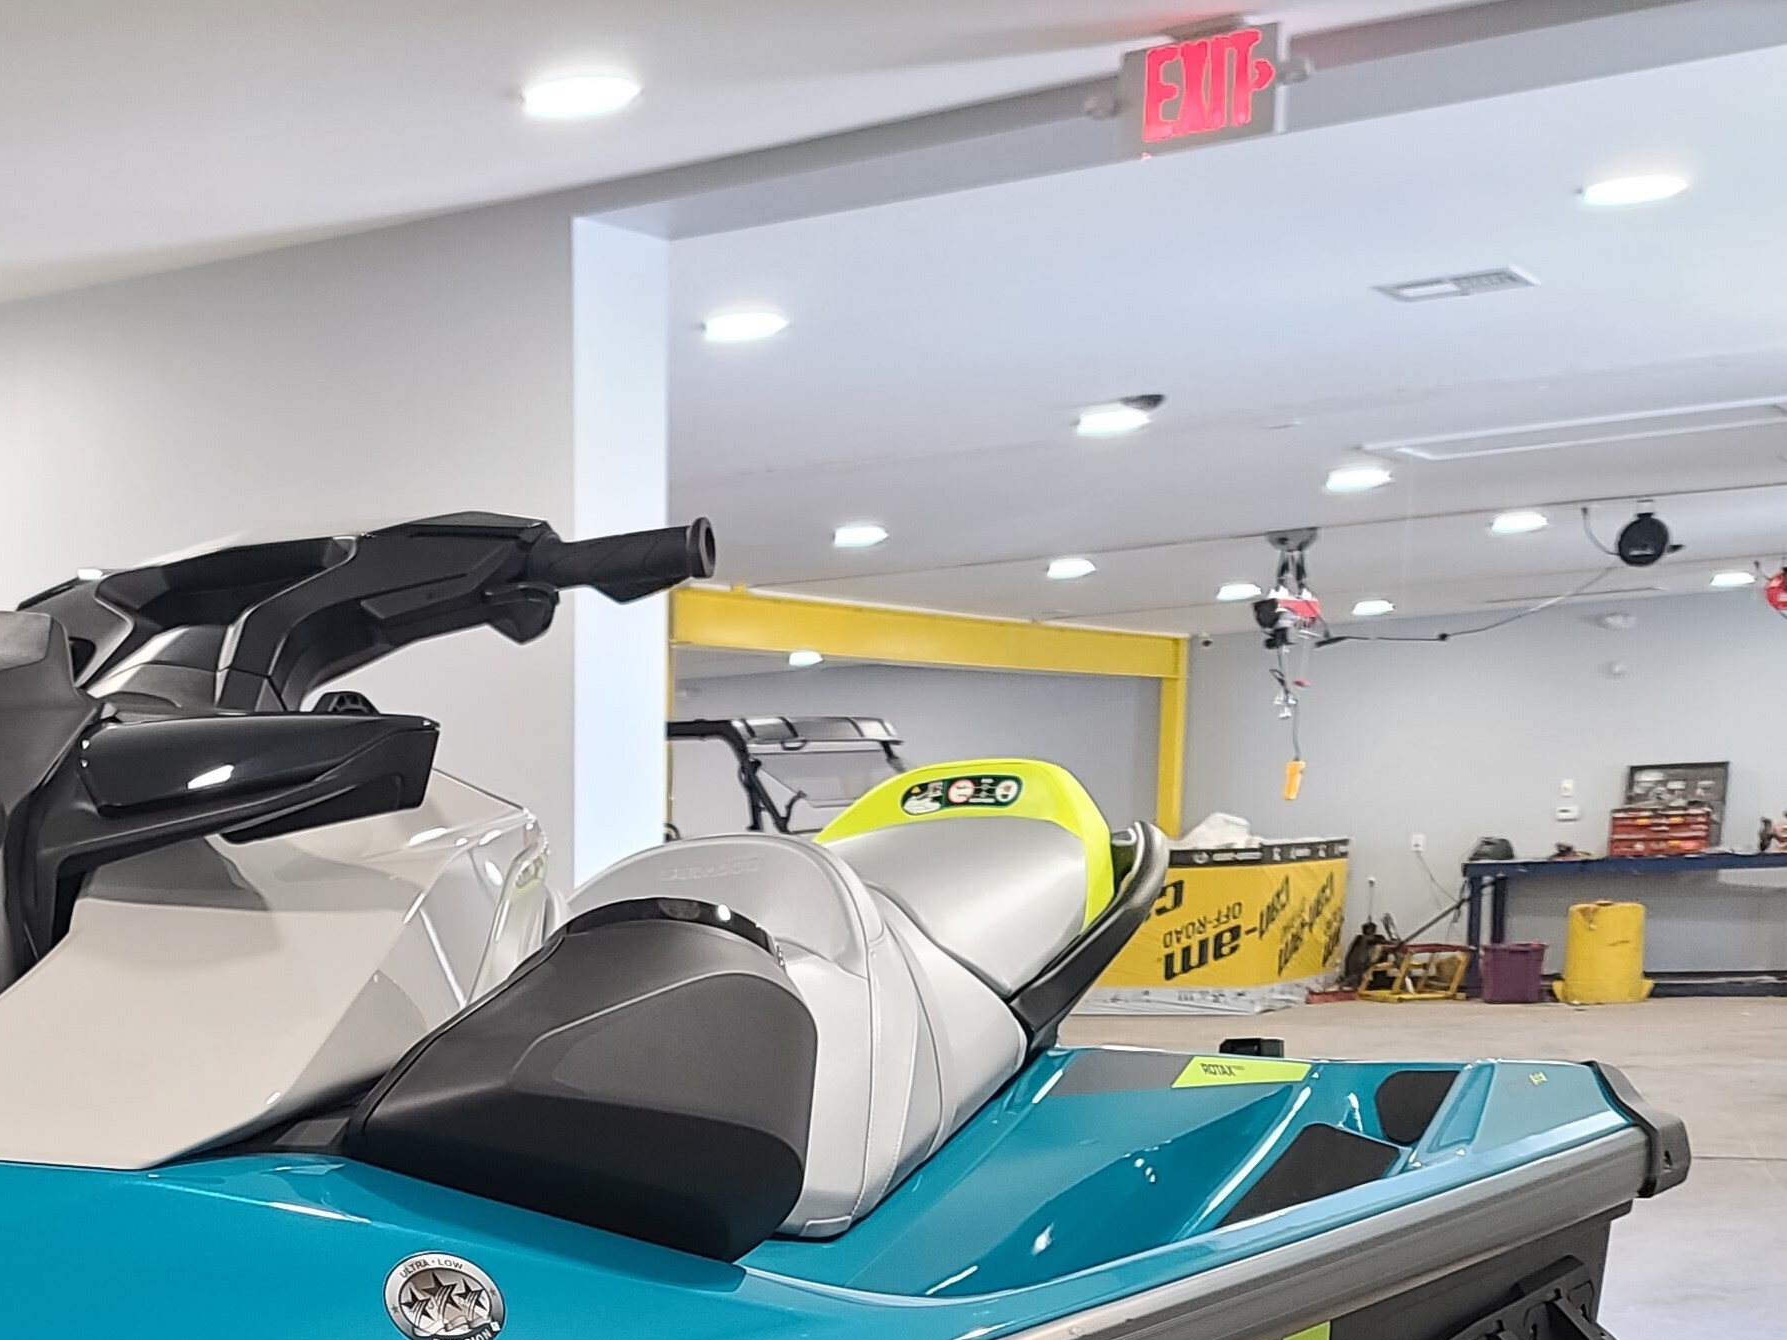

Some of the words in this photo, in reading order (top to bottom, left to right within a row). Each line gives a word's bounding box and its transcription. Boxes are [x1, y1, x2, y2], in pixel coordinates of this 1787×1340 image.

[1143, 29, 1262, 142] EXIT
[1162, 902, 1243, 948] OFF-ROAD
[1200, 1063, 1236, 1077] ROTAX
[399, 1259, 430, 1279] ULTRA
[438, 1258, 463, 1270] LOW
